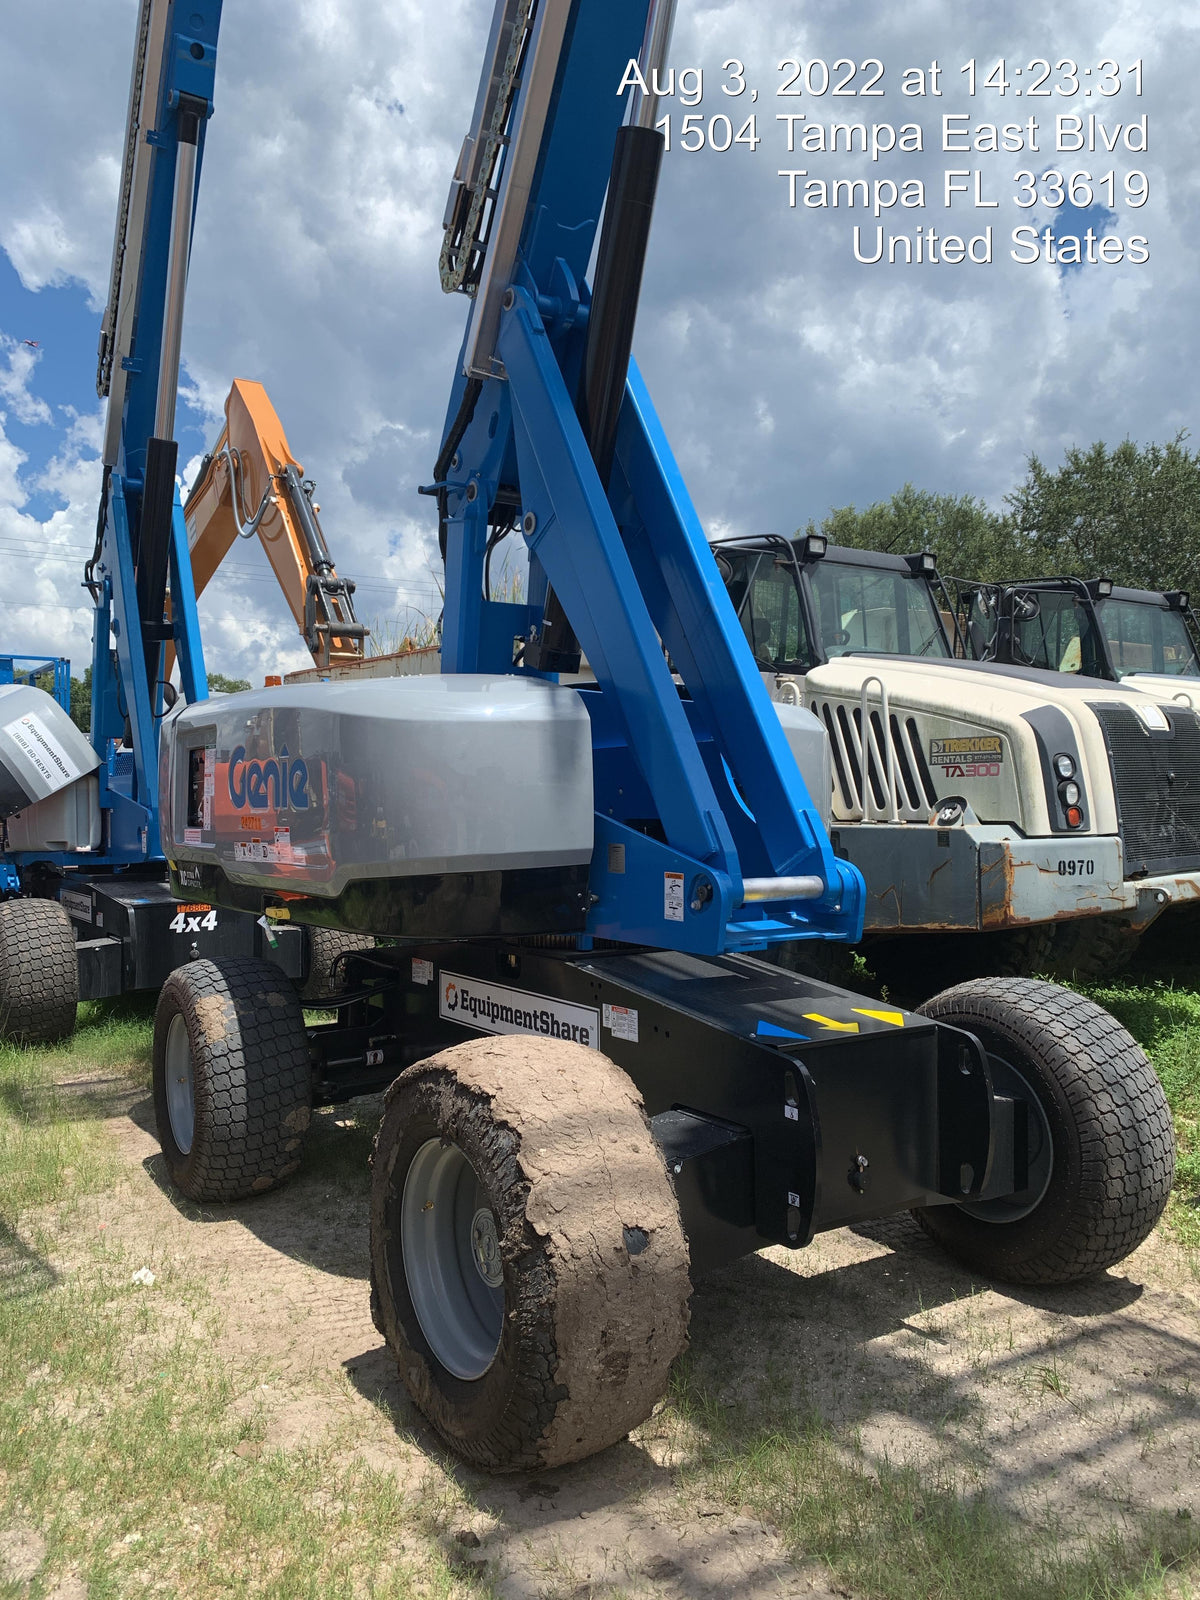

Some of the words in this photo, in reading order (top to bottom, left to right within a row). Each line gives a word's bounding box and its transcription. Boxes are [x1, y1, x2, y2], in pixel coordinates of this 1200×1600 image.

[27, 723, 71, 779] EquipmentShare
[944, 737, 1001, 753] TREKKER
[931, 755, 973, 764] RENTALS
[228, 744, 309, 811] Genie
[941, 763, 1000, 778] TA300
[1057, 859, 1095, 876] 0970
[169, 910, 218, 933] 4x4
[460, 989, 590, 1047] EquipmentShare
